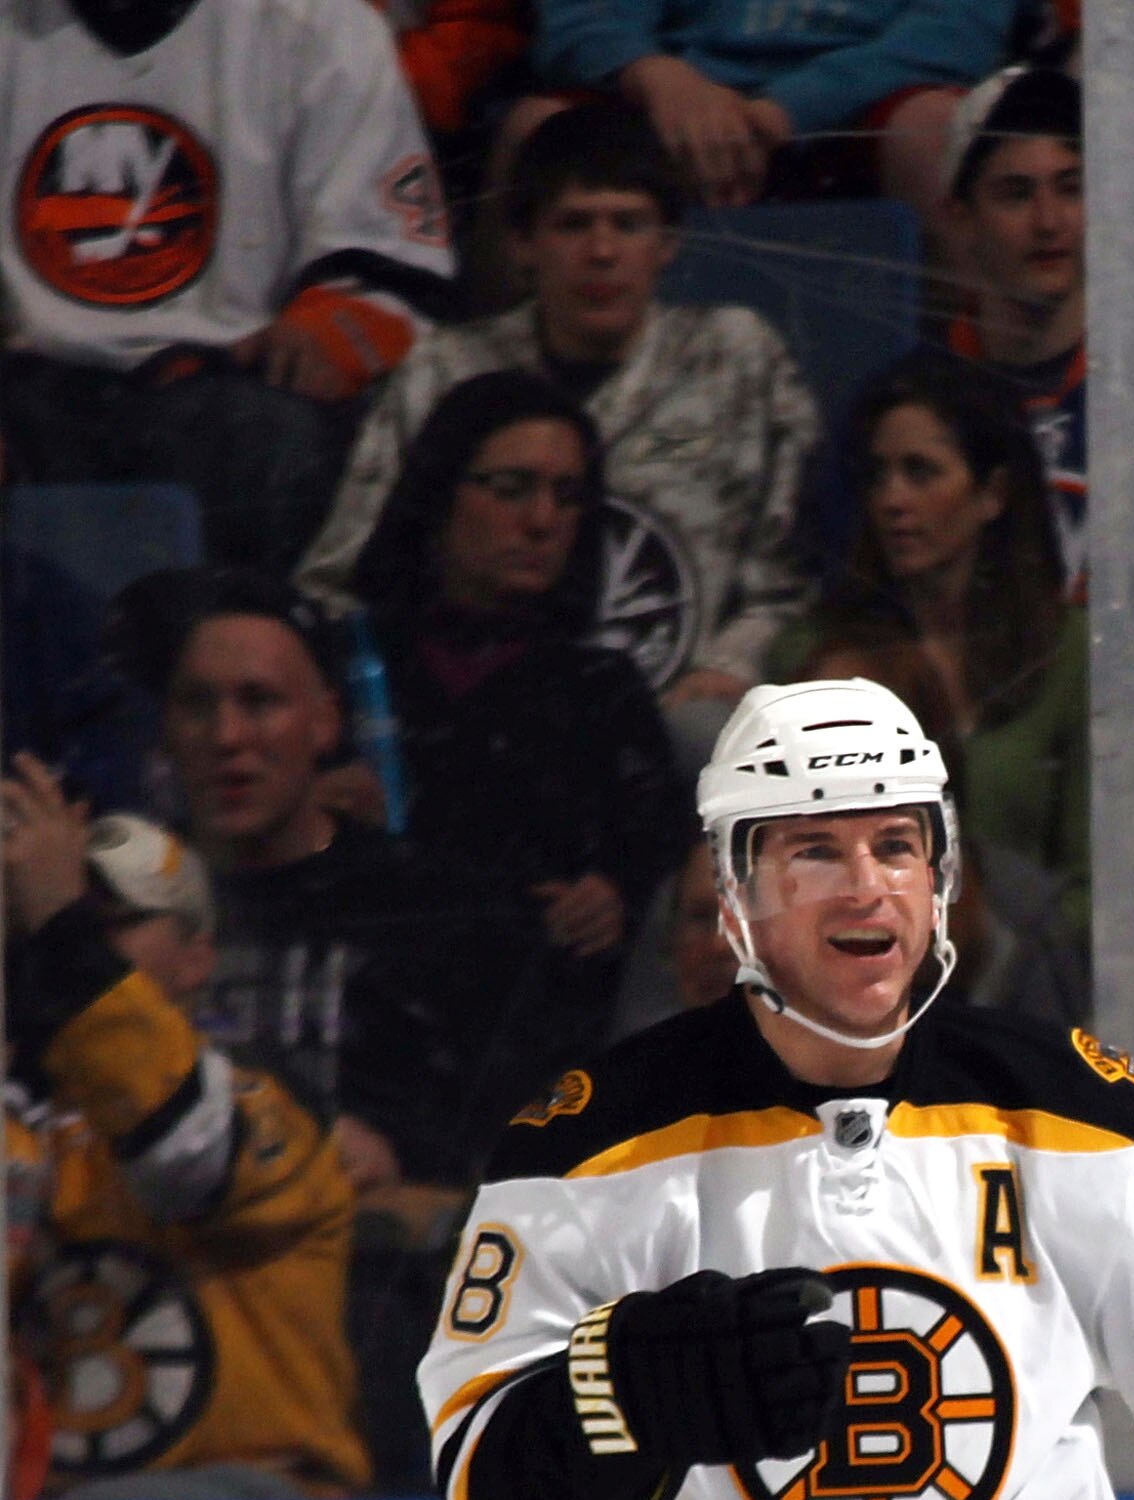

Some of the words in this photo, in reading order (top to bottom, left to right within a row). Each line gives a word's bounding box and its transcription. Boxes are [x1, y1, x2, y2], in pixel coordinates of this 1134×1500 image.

[807, 752, 885, 770] CCM
[972, 1163, 1039, 1284] A
[809, 1329, 942, 1498] B
